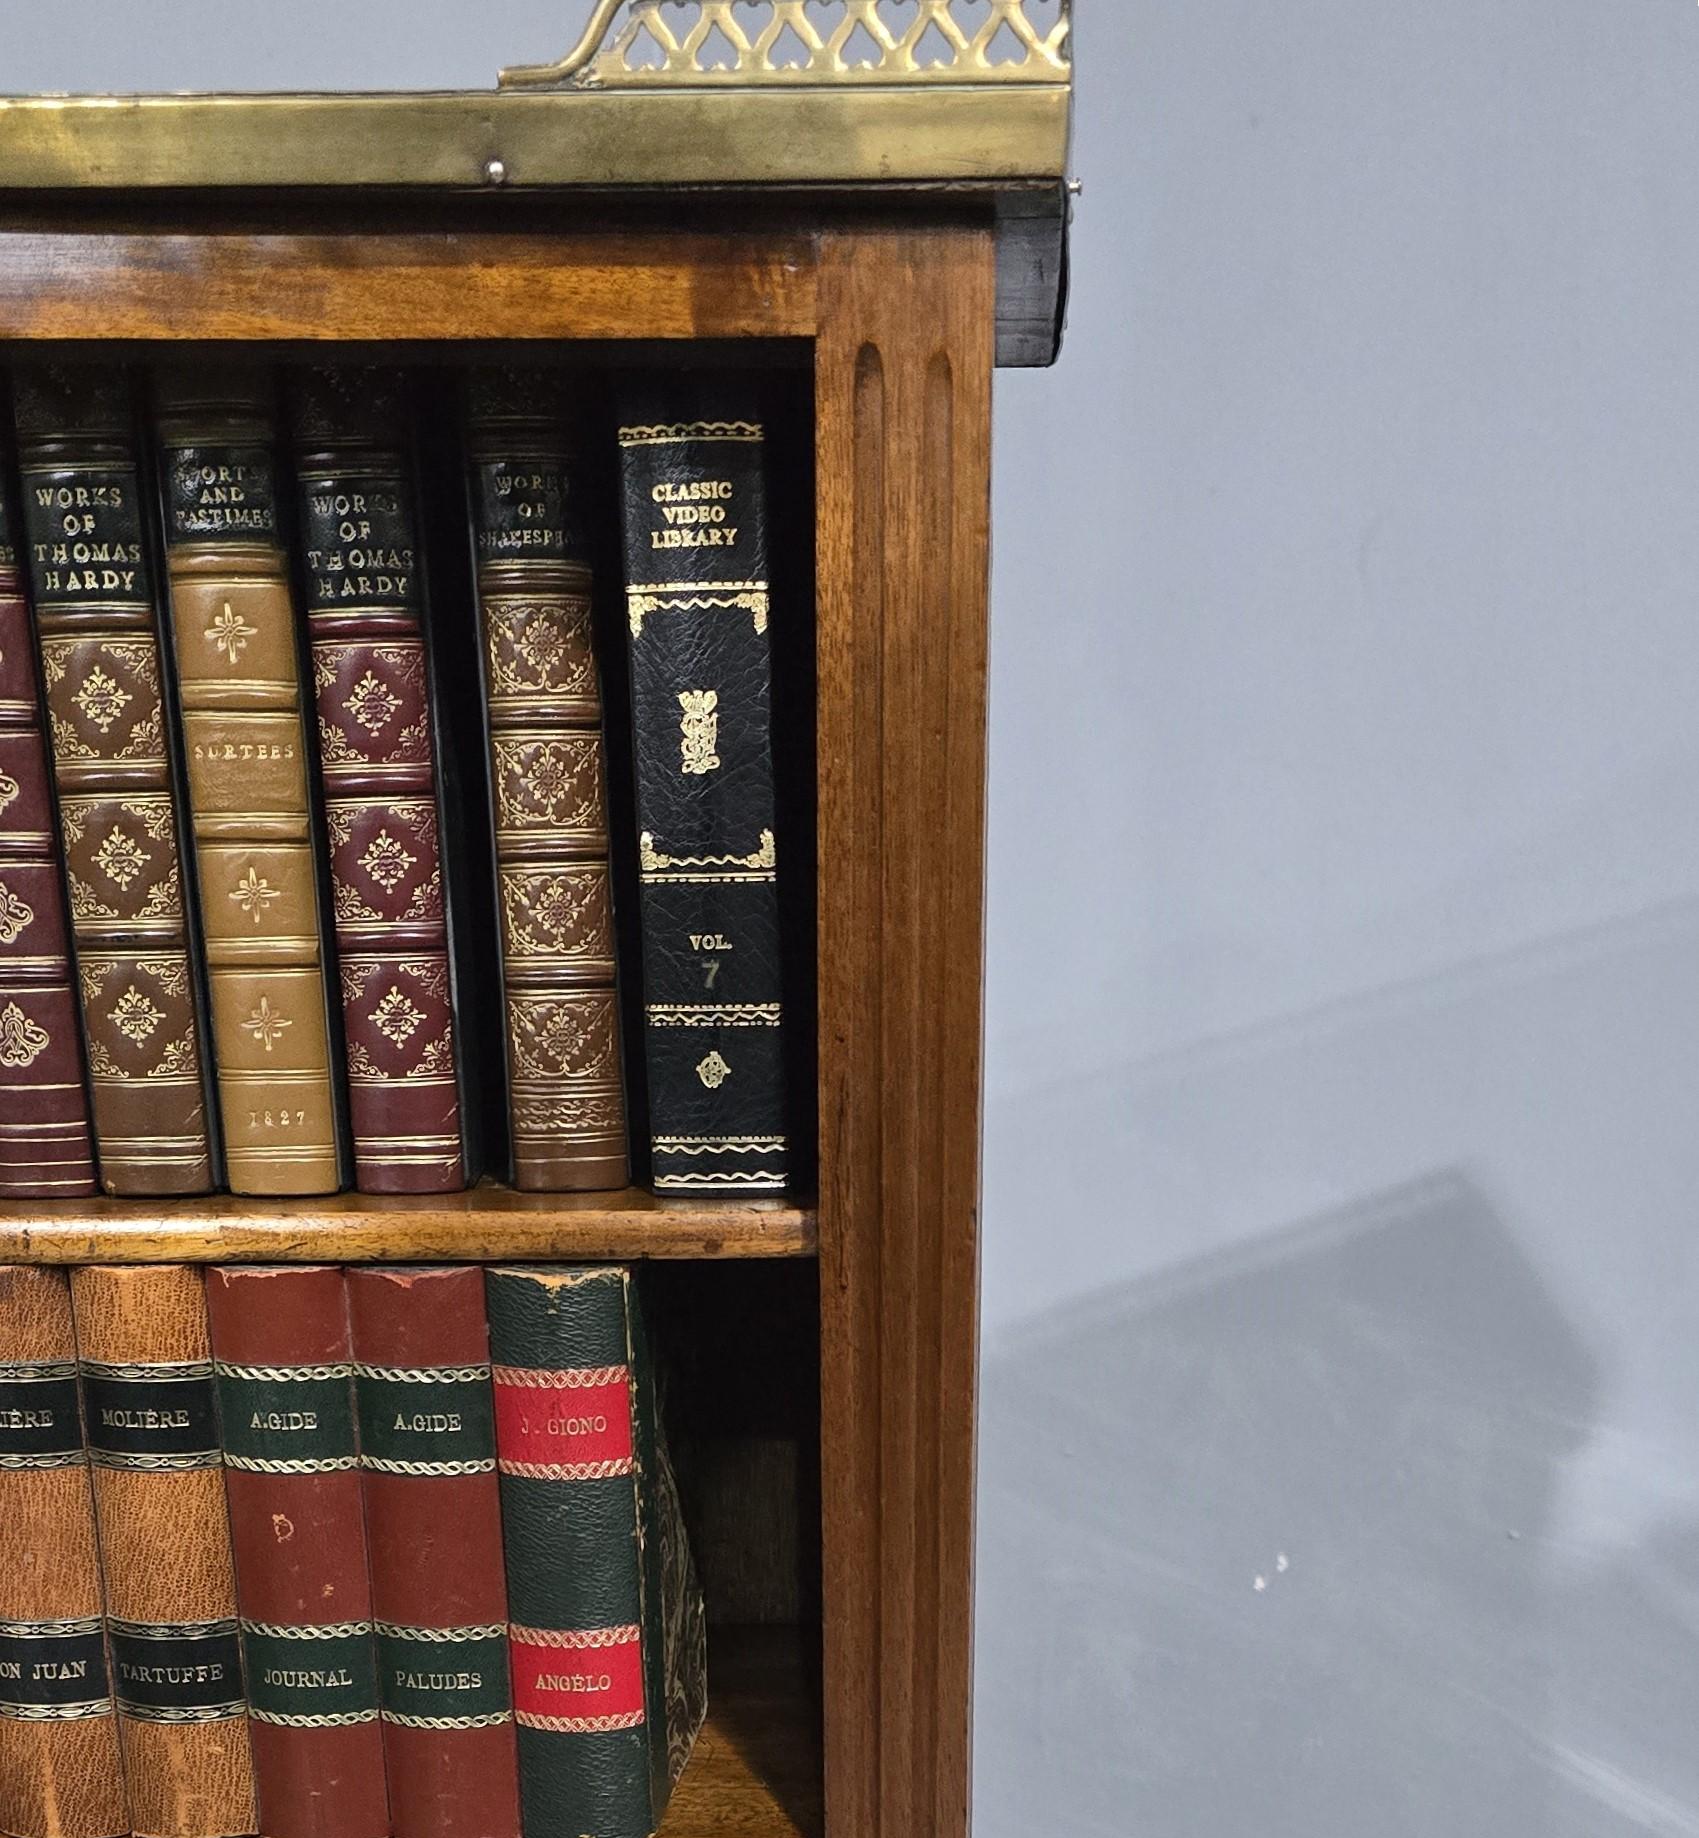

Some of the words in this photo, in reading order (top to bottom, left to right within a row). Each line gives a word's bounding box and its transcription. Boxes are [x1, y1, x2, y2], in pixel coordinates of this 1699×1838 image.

[36, 487, 122, 508] WORKS
[200, 487, 245, 504] AND
[652, 481, 732, 502] CLASSIC
[176, 508, 272, 529] PASTIMES
[662, 506, 726, 524] VIDEO
[63, 515, 96, 536] OF
[340, 521, 371, 542] OF
[651, 528, 738, 548] LIBRARY
[34, 543, 141, 565] THOMAS
[308, 549, 414, 570] THOMAS
[45, 570, 135, 591] HARDY
[319, 576, 407, 598] HARDY
[195, 744, 293, 759] SURTEES
[689, 934, 733, 950] VOL.
[702, 959, 720, 988] 7
[250, 1111, 305, 1126] 1827
[0, 1409, 54, 1429] IÈRE
[547, 1415, 607, 1436] GIONO
[32, 1660, 87, 1680] JUAN
[120, 1664, 224, 1684] TARTUFFE
[264, 1668, 353, 1688] JOURNAL
[396, 1670, 483, 1689] PALUDES
